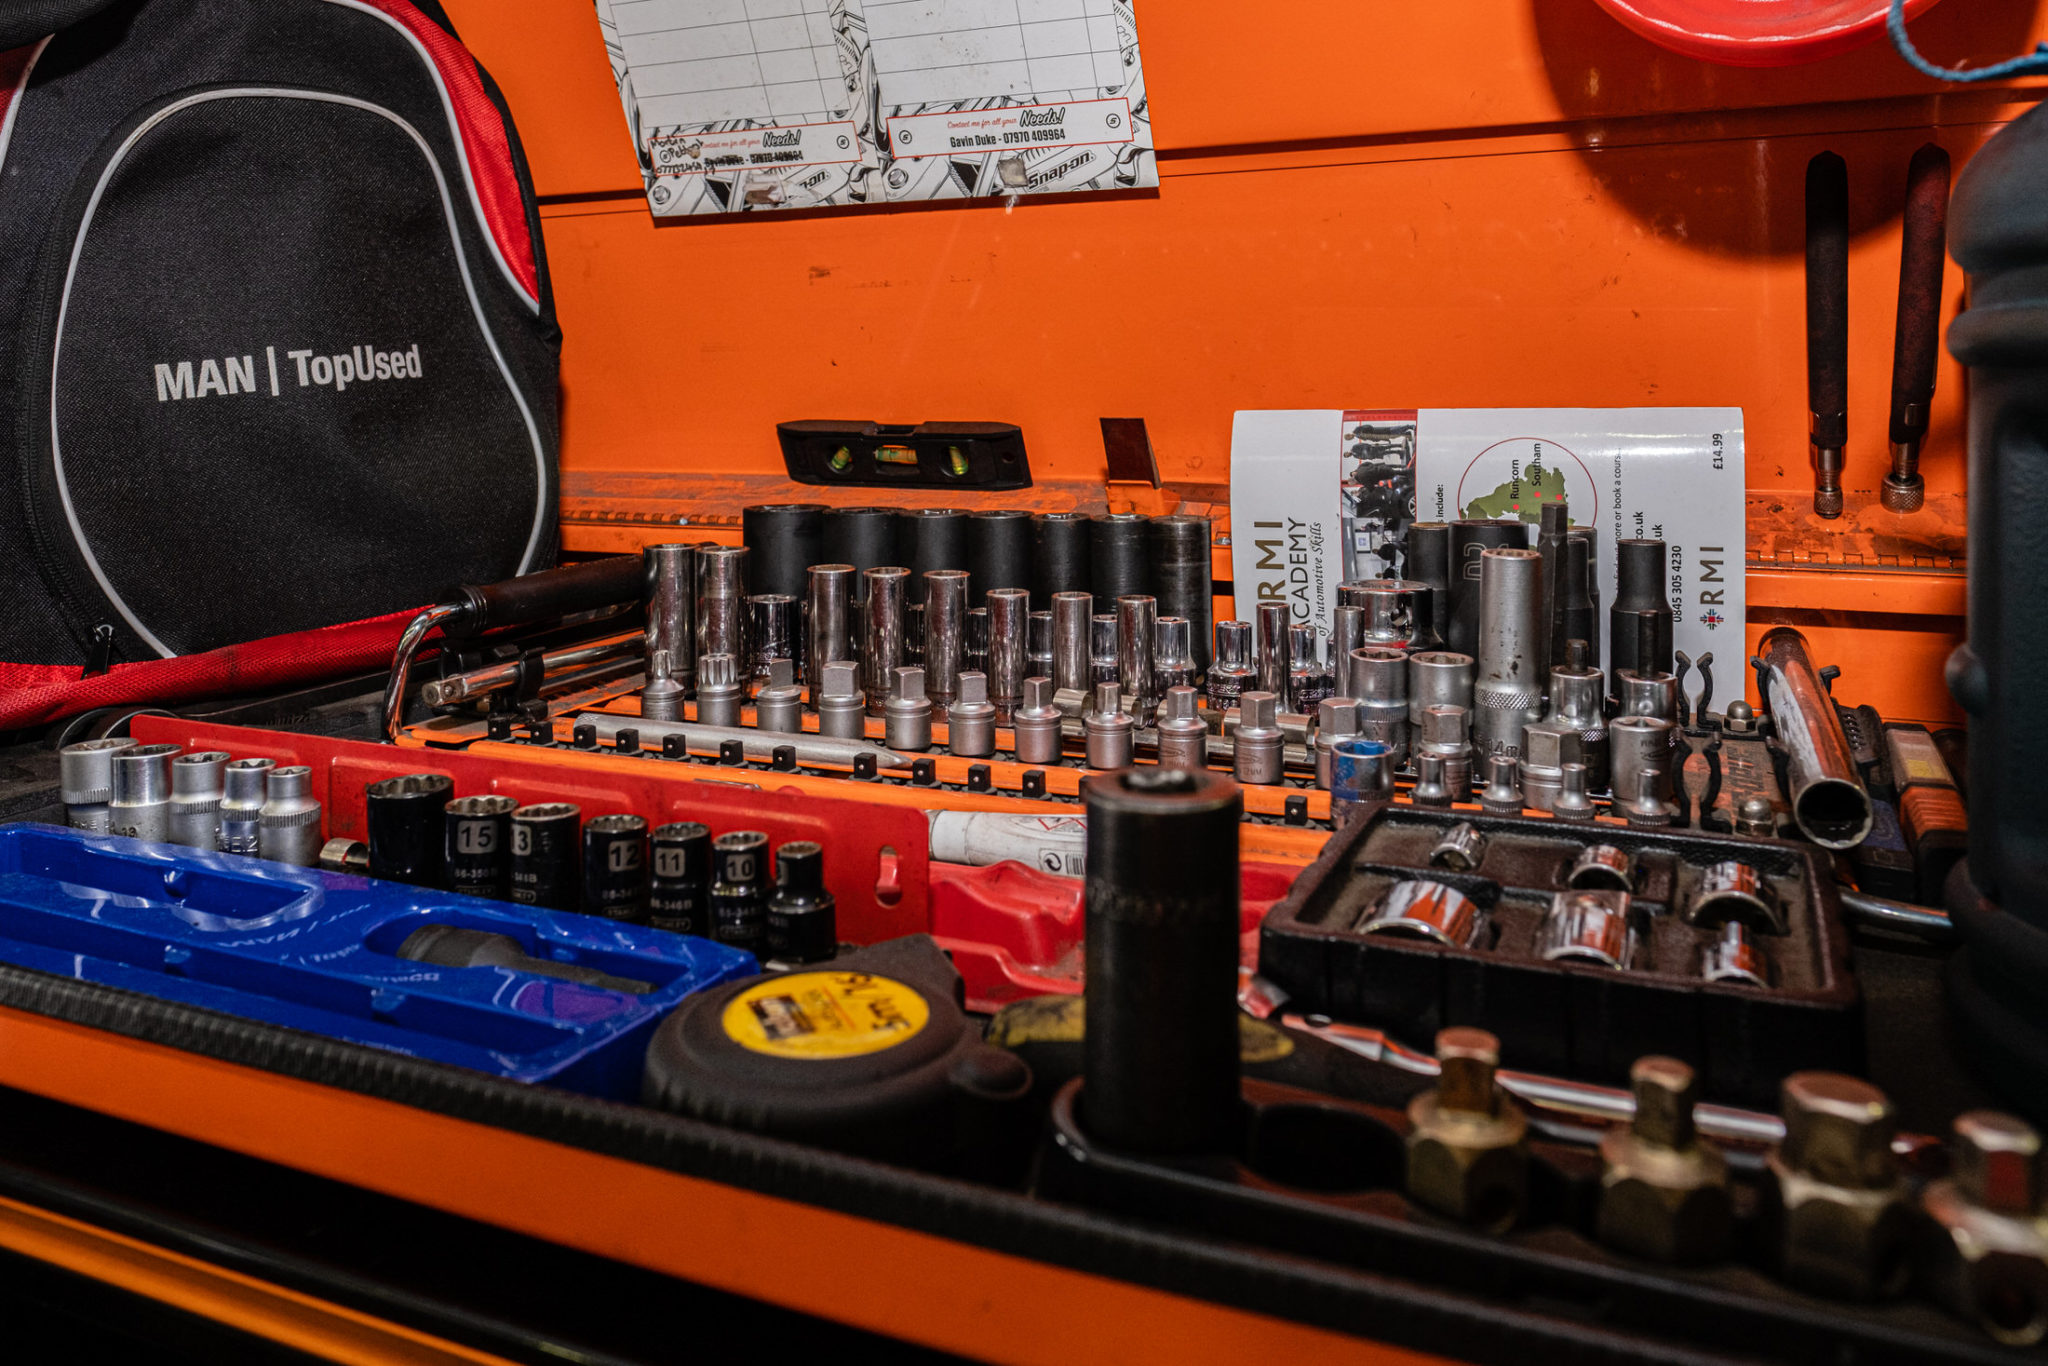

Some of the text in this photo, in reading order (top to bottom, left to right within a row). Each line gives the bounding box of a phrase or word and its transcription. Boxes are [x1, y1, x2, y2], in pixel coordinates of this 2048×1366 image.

[947, 119, 970, 129] Contact
[981, 118, 991, 130] for
[992, 117, 1001, 126] all
[1020, 107, 1066, 127] Needs!
[763, 129, 801, 148] Needs!
[950, 134, 974, 148] Gavin
[976, 133, 997, 146] Duke
[1003, 131, 1030, 144] 07970
[1032, 128, 1066, 142] 409964
[154, 354, 257, 402] MAN
[287, 343, 423, 392] TopUsed
[1712, 433, 1723, 470] £14.99
[1532, 443, 1542, 487] Southam
[1510, 459, 1519, 500] Runcorn
[1436, 484, 1444, 519] include:
[1613, 488, 1622, 509] book
[1615, 511, 1622, 521] or
[1254, 521, 1287, 600] RMI
[1288, 517, 1310, 625] CADEMY
[1672, 545, 1682, 572] 4230
[1309, 522, 1330, 637] of Automotive Skills
[1672, 575, 1682, 595] 305
[1700, 547, 1724, 605] RMI
[460, 825, 492, 848] 15
[610, 844, 640, 867] 12
[657, 852, 680, 871] 11
[727, 860, 753, 879] 10
